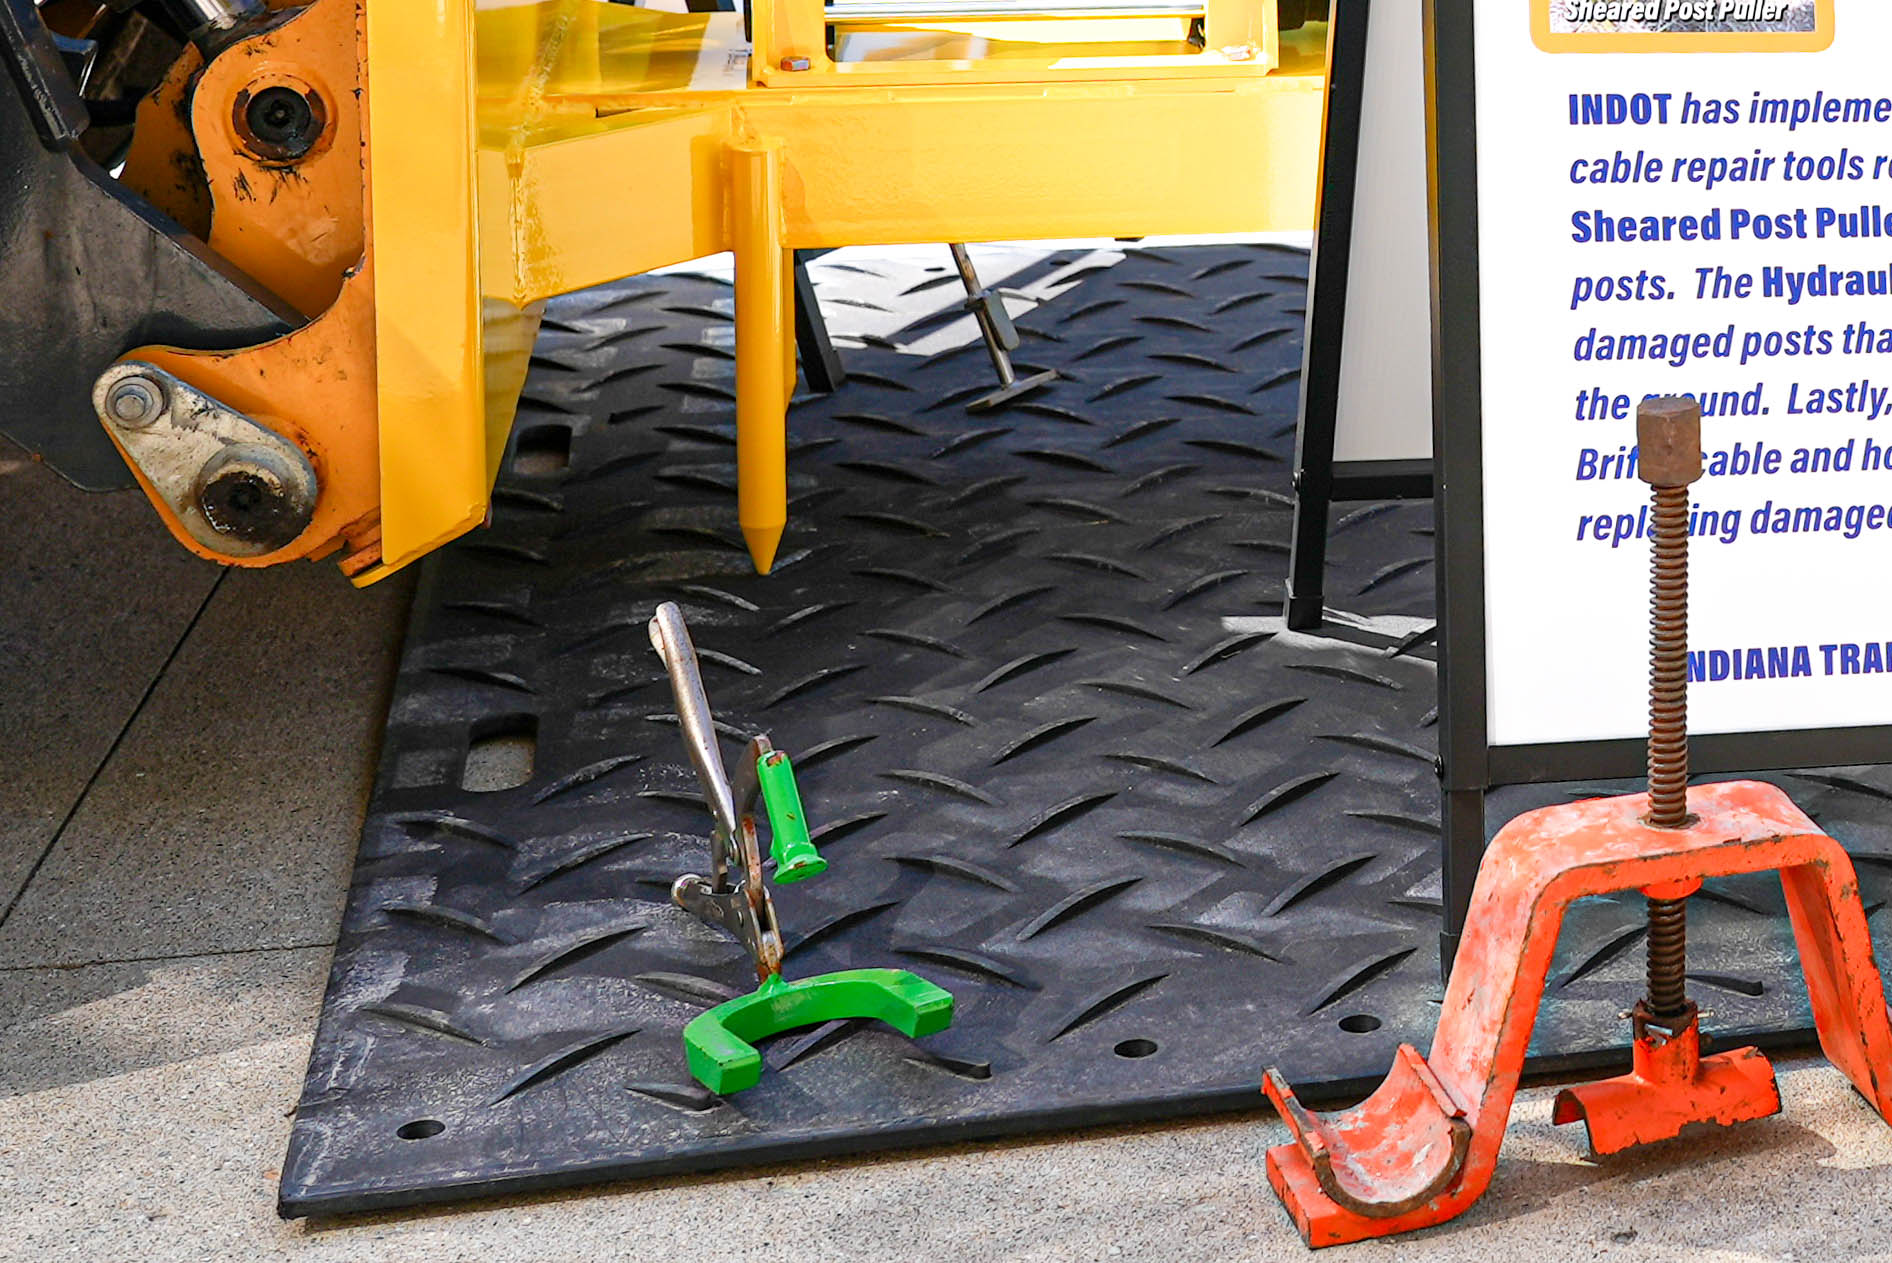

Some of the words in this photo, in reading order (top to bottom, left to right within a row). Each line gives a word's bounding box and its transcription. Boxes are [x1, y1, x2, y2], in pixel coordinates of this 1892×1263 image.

[1568, 92, 1673, 126] INDOT
[1681, 92, 1741, 125] has
[1569, 150, 1664, 185] cable
[1672, 148, 1776, 191] repair
[1783, 148, 1865, 182] tools
[1571, 207, 1721, 244] Sheared
[1730, 208, 1808, 240] Post
[1570, 269, 1675, 311] posts.
[1695, 266, 1753, 300] The
[1574, 325, 1735, 368] damaged
[1740, 324, 1833, 366] posts
[1575, 386, 1631, 421] the
[1642, 382, 1769, 417] und.
[1787, 380, 1892, 421] Lastly,
[1790, 439, 1855, 473] and
[1577, 502, 1742, 548] repling
[1687, 645, 1813, 683] NDIANA
